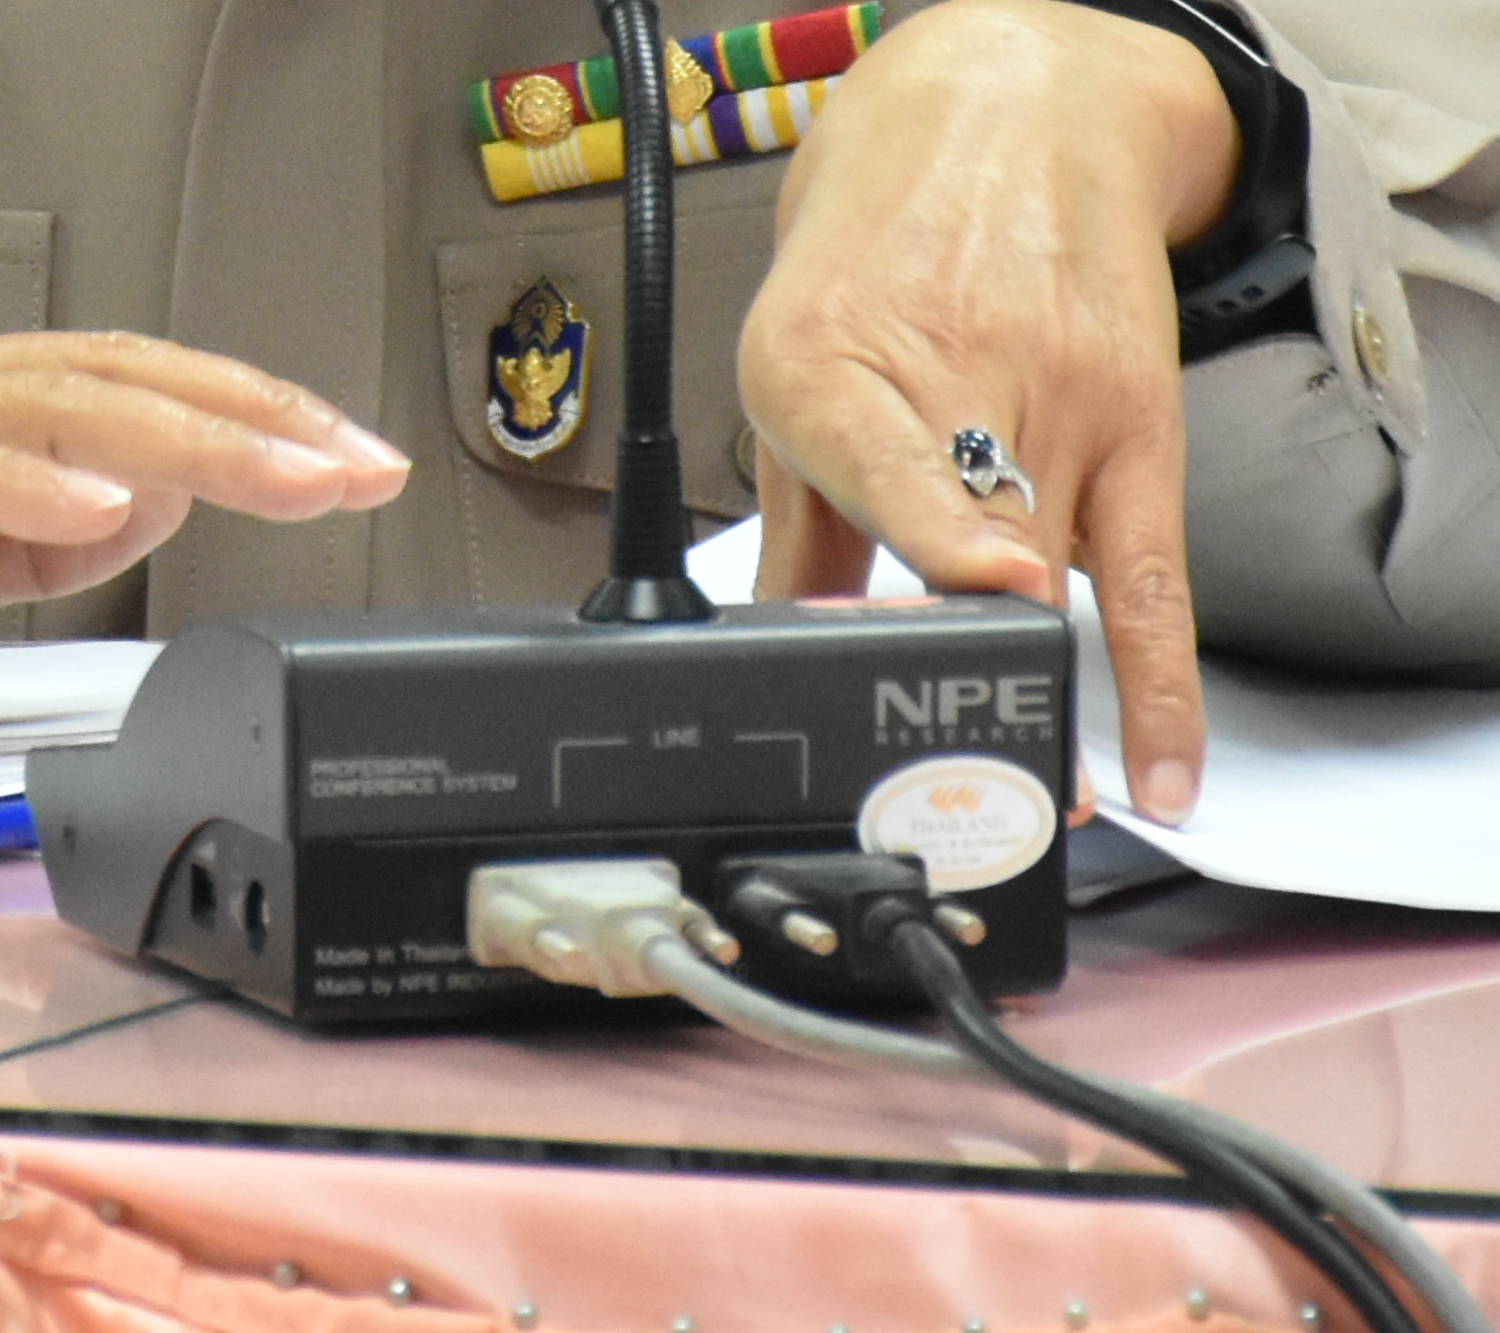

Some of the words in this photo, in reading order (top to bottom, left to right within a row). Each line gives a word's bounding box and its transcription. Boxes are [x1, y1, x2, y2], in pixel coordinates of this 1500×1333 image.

[875, 676, 1052, 726] NPE
[653, 727, 699, 749] LINE
[443, 774, 517, 793] SYSTEM
[315, 947, 369, 967] Made
[315, 977, 365, 996] Made
[371, 975, 392, 998] by
